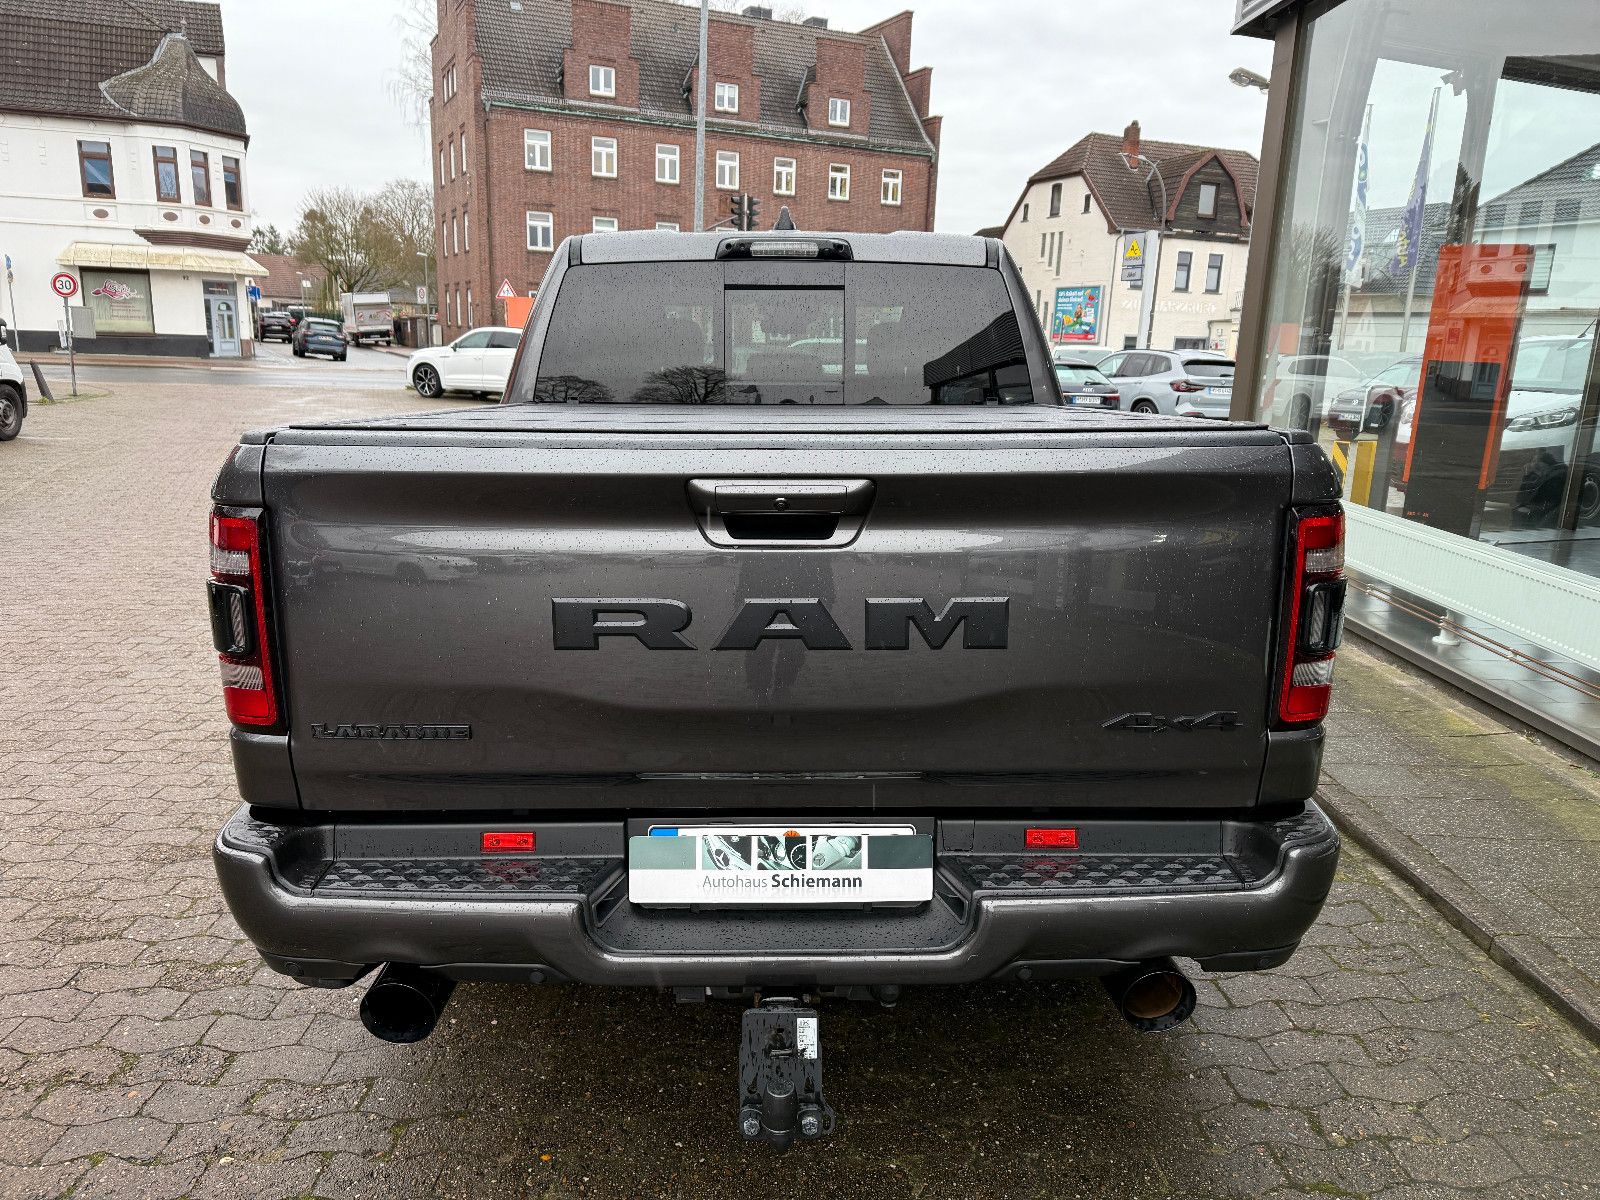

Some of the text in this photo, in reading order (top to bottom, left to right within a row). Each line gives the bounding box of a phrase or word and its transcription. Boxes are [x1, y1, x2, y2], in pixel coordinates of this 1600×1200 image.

[57, 279, 72, 291] 30
[551, 596, 1010, 652] RAM
[311, 723, 473, 740] LARAMIE
[702, 873, 863, 888] Autohaus Schiemann
